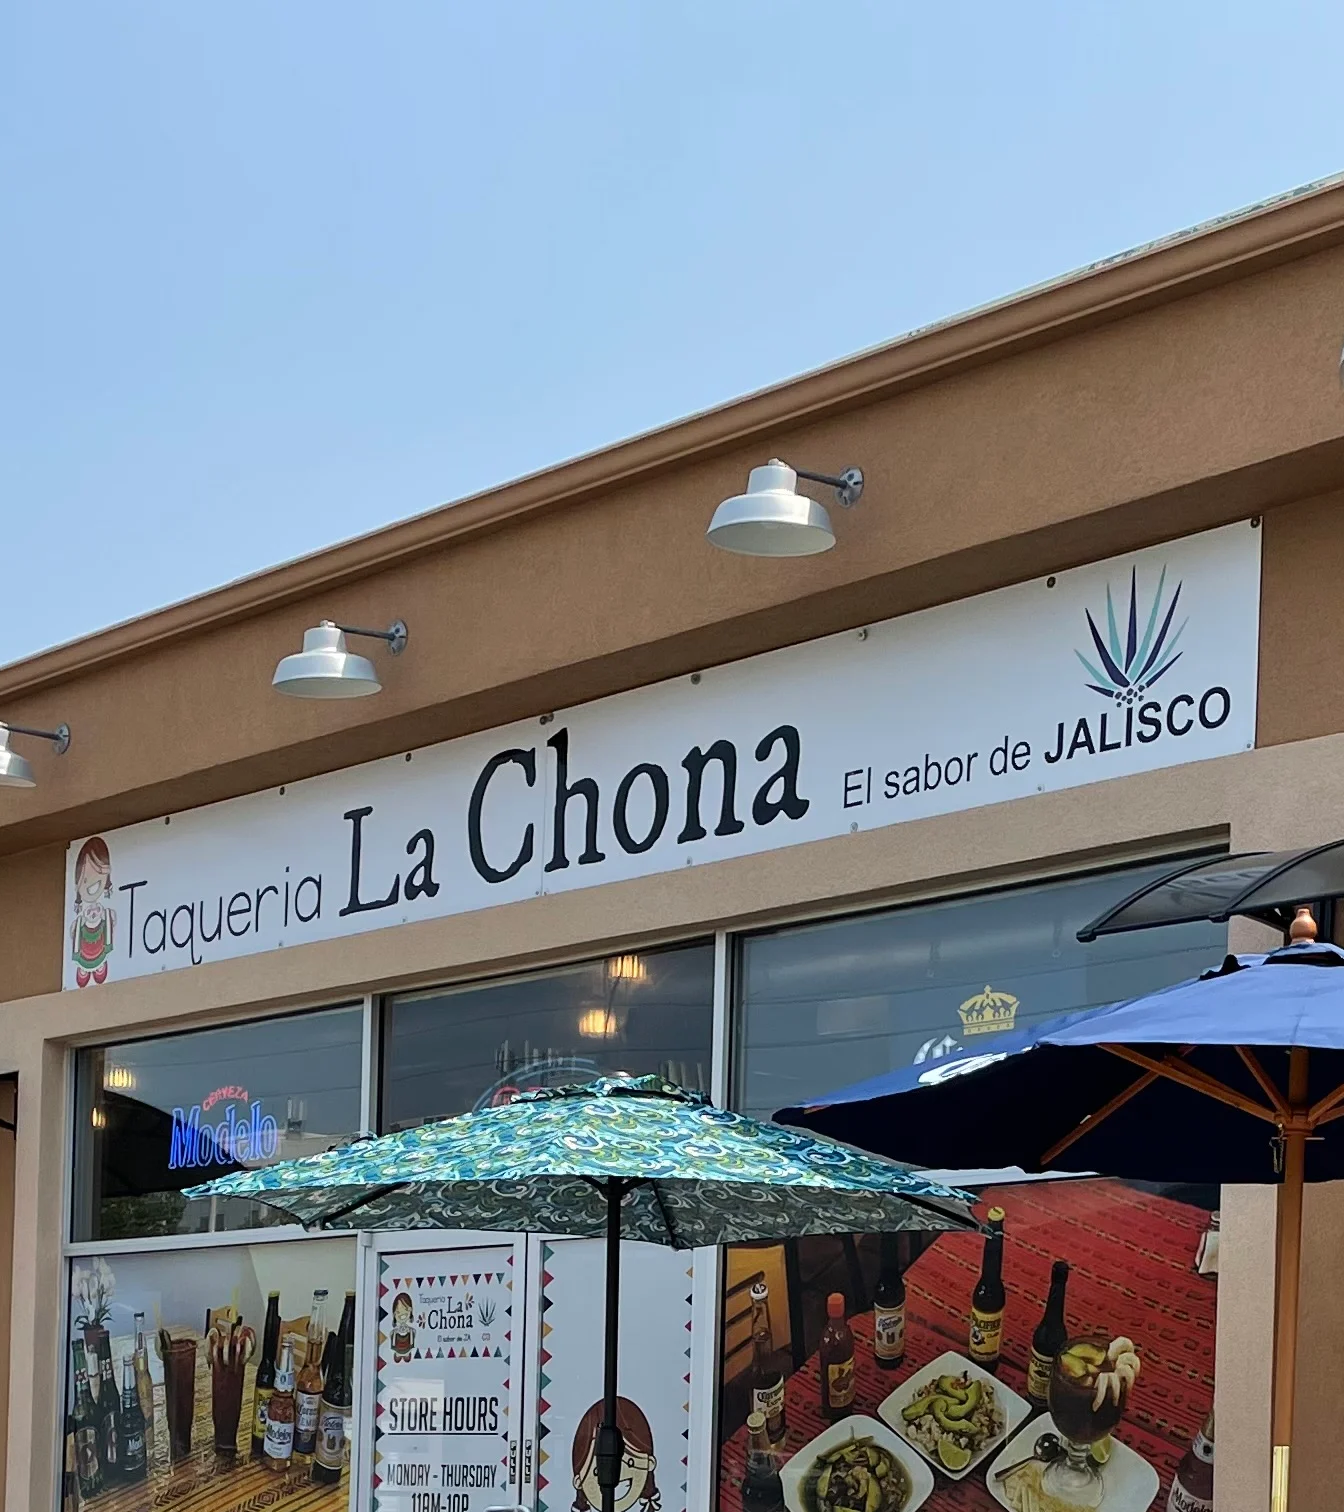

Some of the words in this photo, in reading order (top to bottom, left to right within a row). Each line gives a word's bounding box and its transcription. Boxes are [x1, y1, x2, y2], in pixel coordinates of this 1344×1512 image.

[842, 766, 872, 809] El
[883, 751, 979, 799] sabor
[989, 735, 1031, 776] de
[1044, 686, 1232, 764] JALISCO
[119, 866, 323, 965] Taqueria
[339, 806, 441, 917] La
[468, 724, 810, 883] Chona
[202, 1085, 249, 1111] CERVEZA
[168, 1100, 277, 1170] Modelo
[428, 1309, 474, 1330] Chona
[447, 1296, 463, 1314] La
[389, 1397, 438, 1431] STORE
[442, 1397, 499, 1431] HOURS
[387, 1464, 431, 1486] MONDAY
[441, 1464, 497, 1488] THURSDAY
